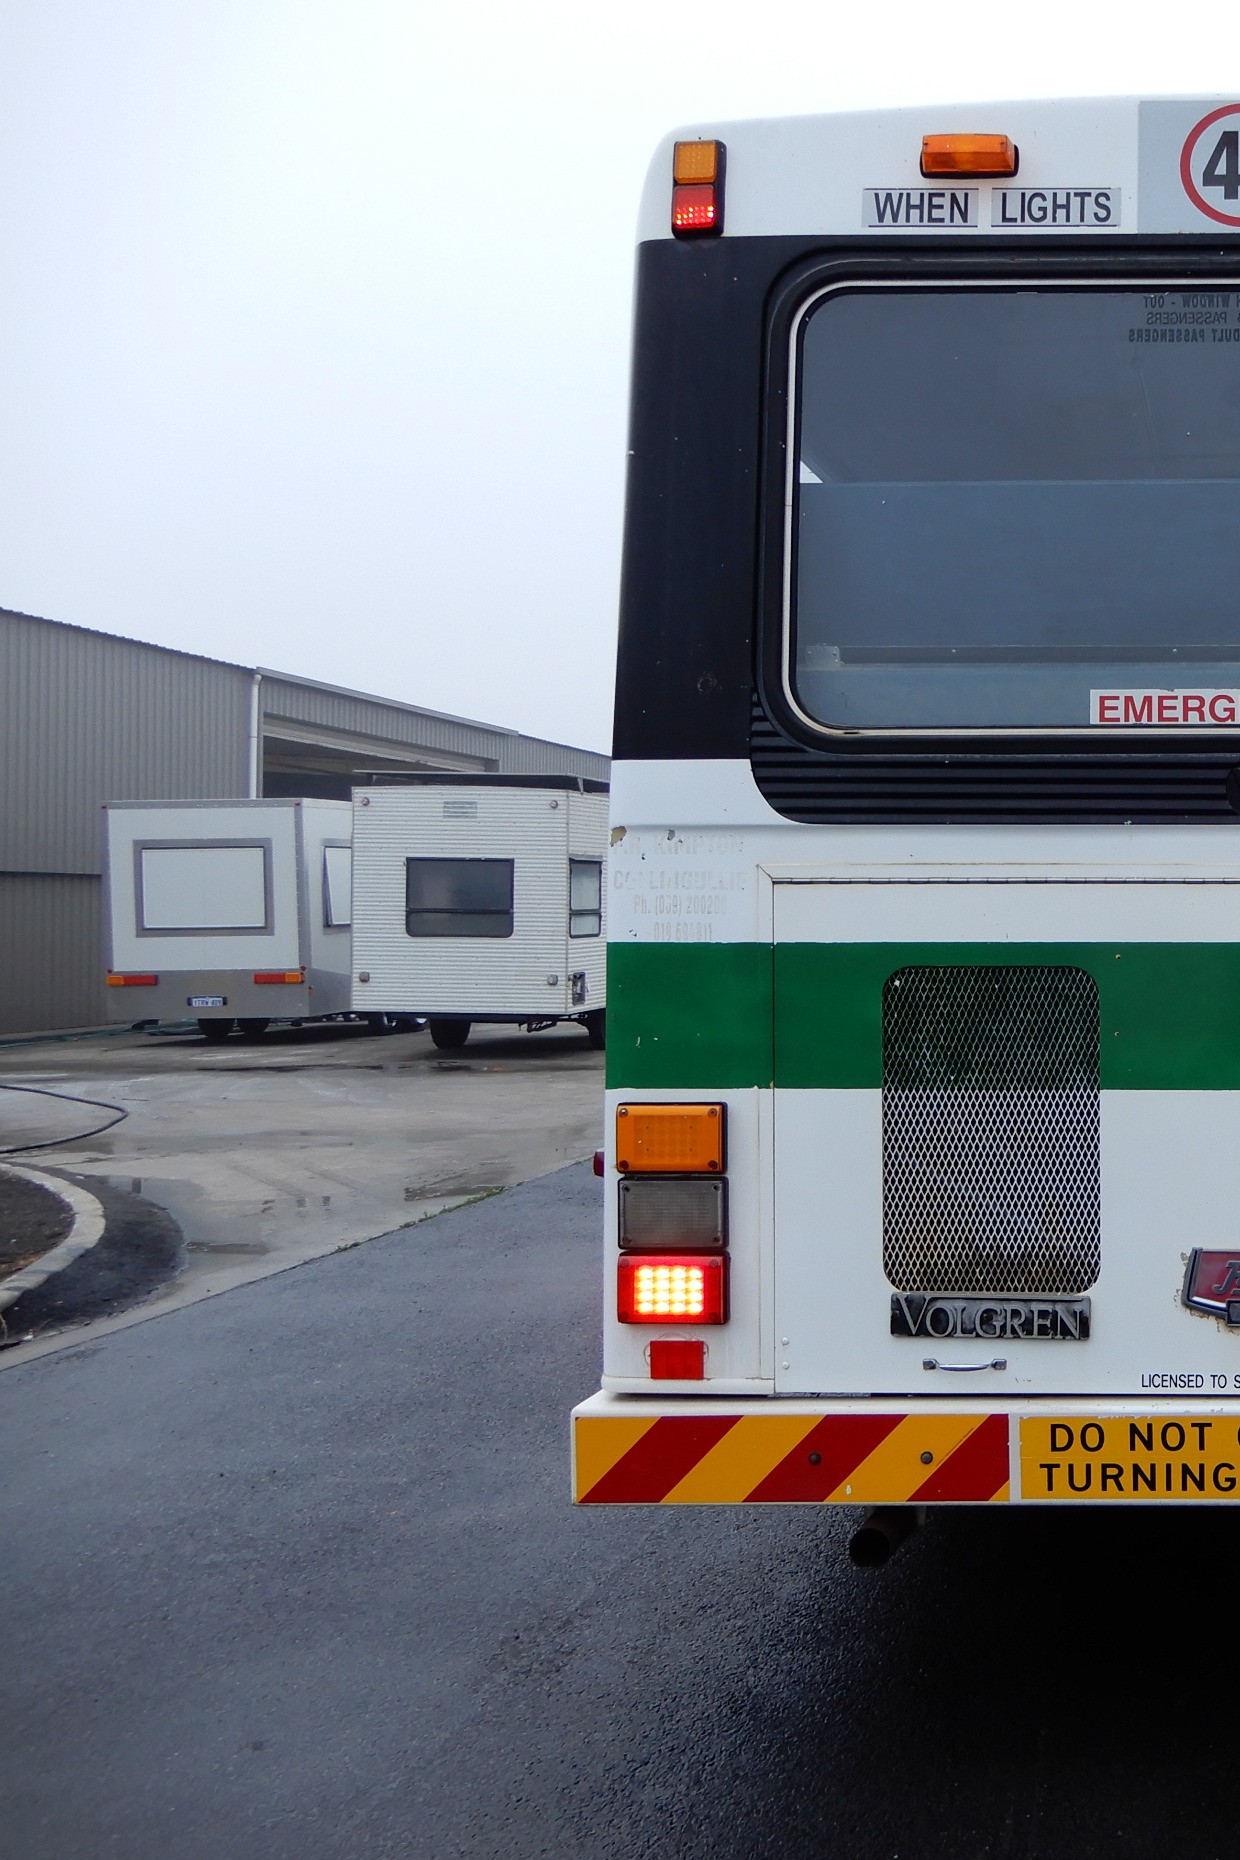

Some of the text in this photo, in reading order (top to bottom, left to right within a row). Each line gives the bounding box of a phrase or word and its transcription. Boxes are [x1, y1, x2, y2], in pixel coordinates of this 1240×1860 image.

[873, 191, 1112, 224] WHEN LIGHTS
[900, 1298, 1084, 1339] VOLGREN
[1141, 1374, 1204, 1388] LICENSED
[1210, 1374, 1227, 1389] TO
[1050, 1422, 1105, 1452] DO
[1129, 1422, 1213, 1452] NOT
[1039, 1462, 1237, 1492] TURNING
